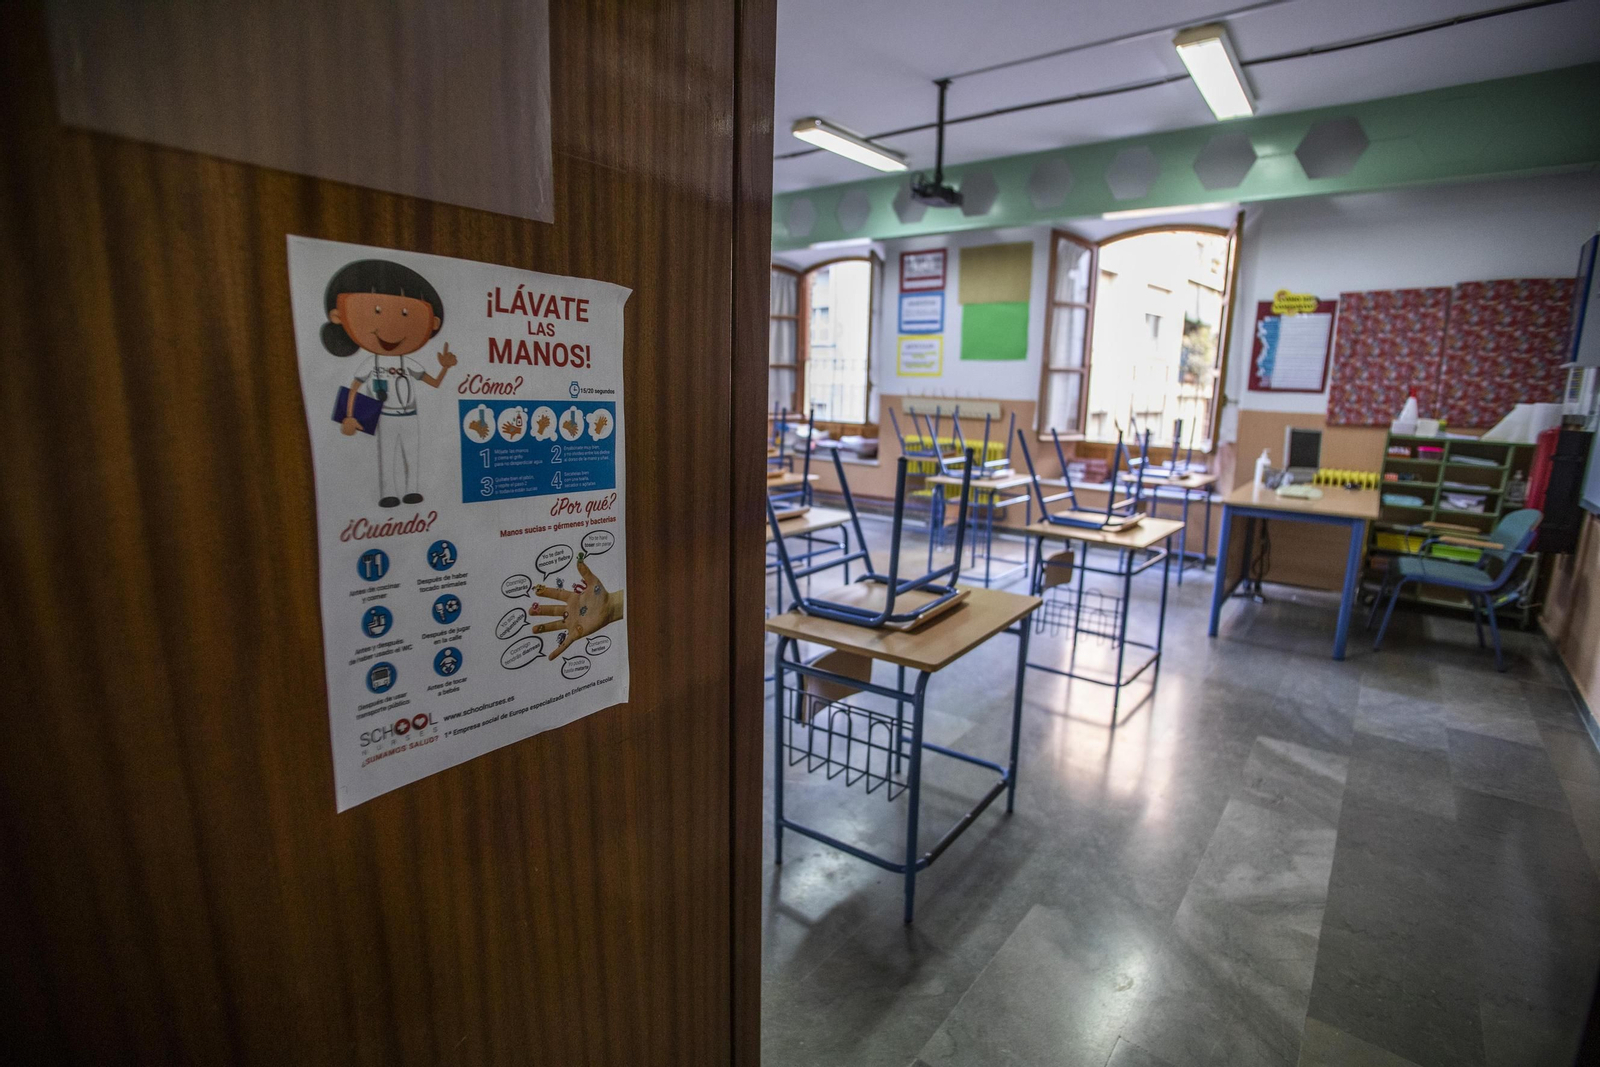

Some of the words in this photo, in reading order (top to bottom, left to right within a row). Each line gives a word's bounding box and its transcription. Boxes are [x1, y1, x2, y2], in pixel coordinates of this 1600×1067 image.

[487, 284, 590, 323] ¡LÁVATE
[528, 320, 555, 337] LAS
[488, 337, 591, 369] MANOS!
[458, 374, 524, 396] ¿Cómo?
[479, 448, 490, 468] 1
[551, 445, 562, 464] 2
[480, 476, 494, 496] 3
[551, 471, 563, 489] 4
[550, 497, 583, 517] ¿Por
[585, 492, 617, 518] qué?
[340, 511, 438, 542] ¿Cuándo?
[500, 528, 523, 538] Manos
[524, 525, 547, 534] sucias
[553, 520, 585, 532] gérmenes
[590, 515, 616, 526] bacterias
[443, 696, 516, 722] www.schoolnurses.es
[453, 723, 481, 736] Empresa
[481, 714, 500, 726] social
[500, 712, 508, 720] de
[509, 706, 529, 718] Europa
[529, 693, 564, 712] especializada
[571, 681, 596, 696] Enfermería
[596, 675, 615, 686] Escolar
[360, 713, 439, 747] SCHOOL
